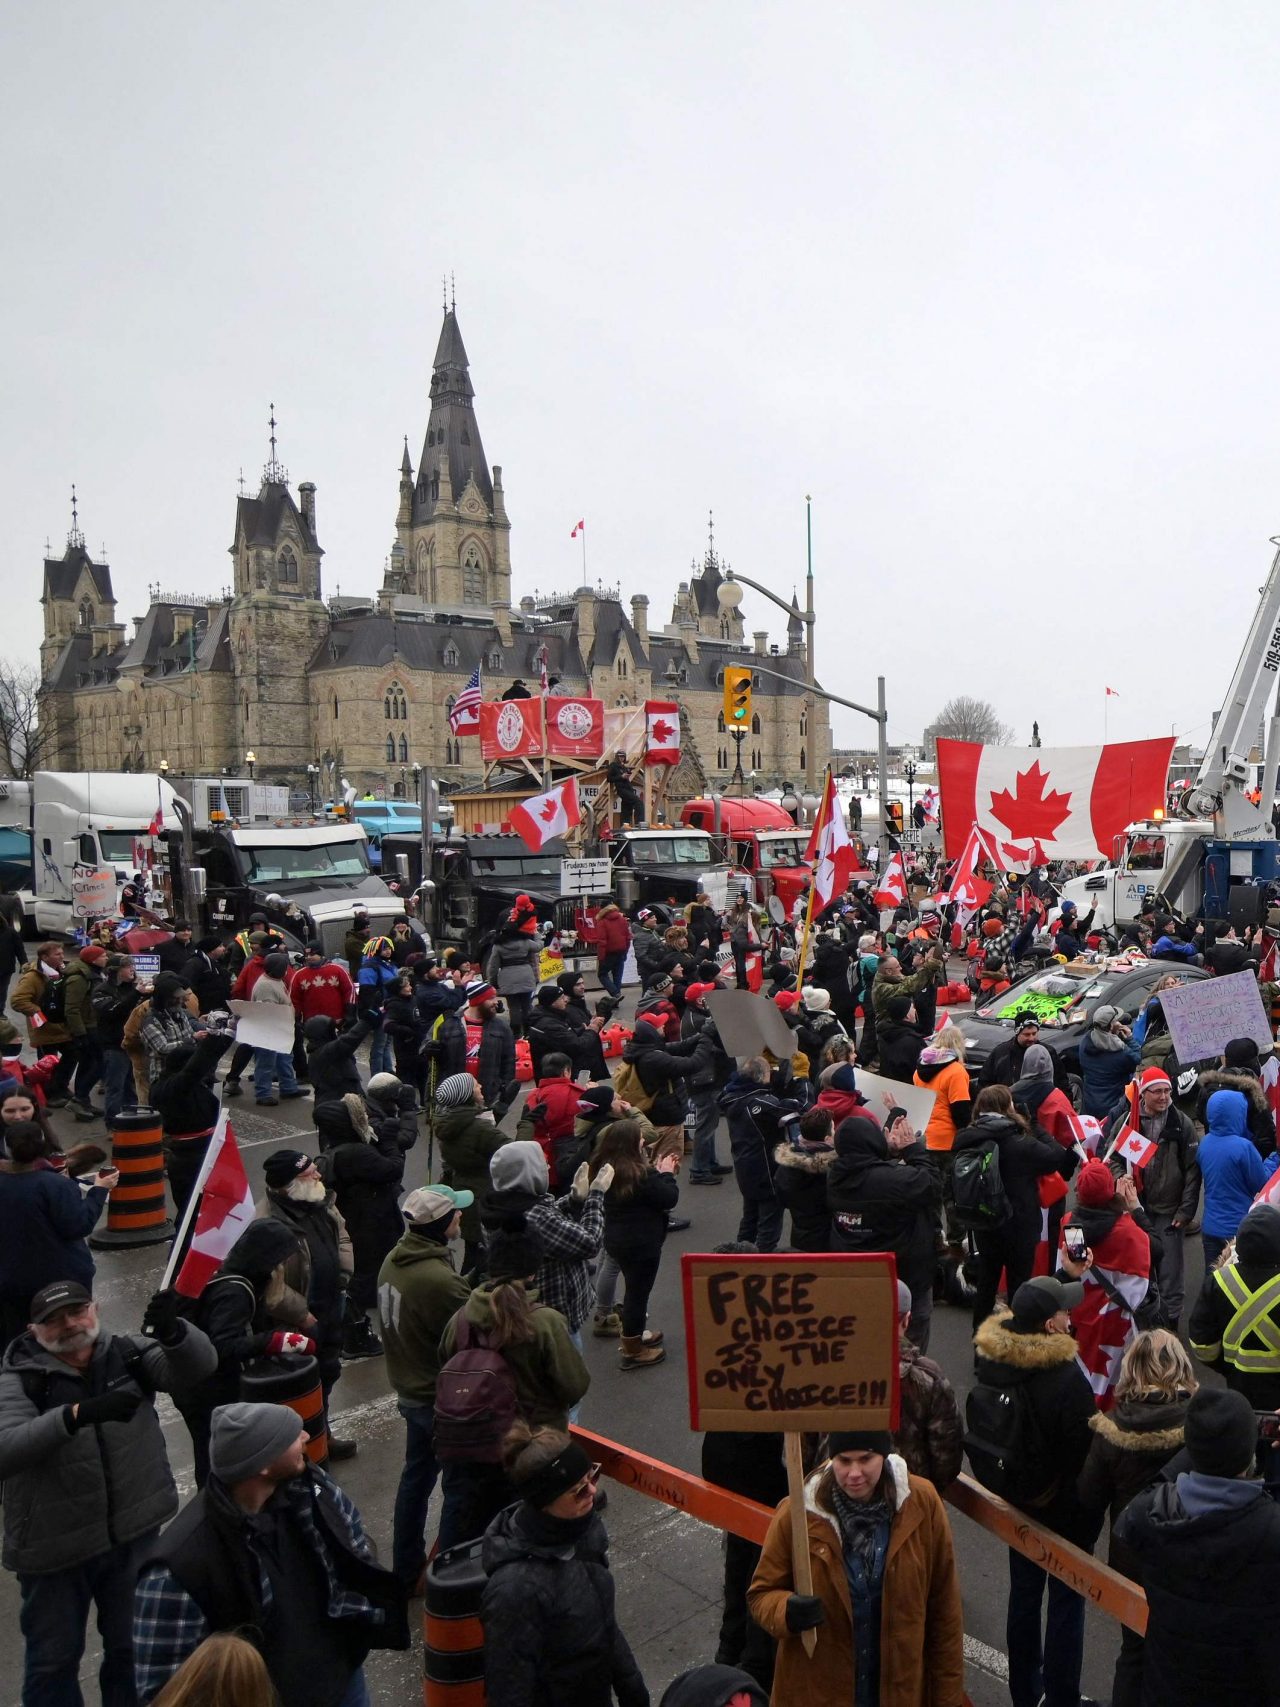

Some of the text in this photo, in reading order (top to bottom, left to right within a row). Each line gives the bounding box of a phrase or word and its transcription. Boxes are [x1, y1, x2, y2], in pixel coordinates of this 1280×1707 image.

[561, 705, 590, 719] LIVE FROM
[74, 868, 94, 879] NO
[1128, 883, 1155, 893] ABS
[1201, 982, 1250, 999] CANADA
[1188, 1001, 1242, 1024] SUPPORTS
[1186, 1020, 1256, 1047] MINORITIES
[838, 1215, 862, 1226] MLM
[707, 1271, 818, 1325] FREE
[731, 1315, 858, 1342] CHOICE
[715, 1340, 850, 1367] IS THE
[704, 1363, 785, 1392] ONLY
[744, 1379, 888, 1411] CHOICE!!!
